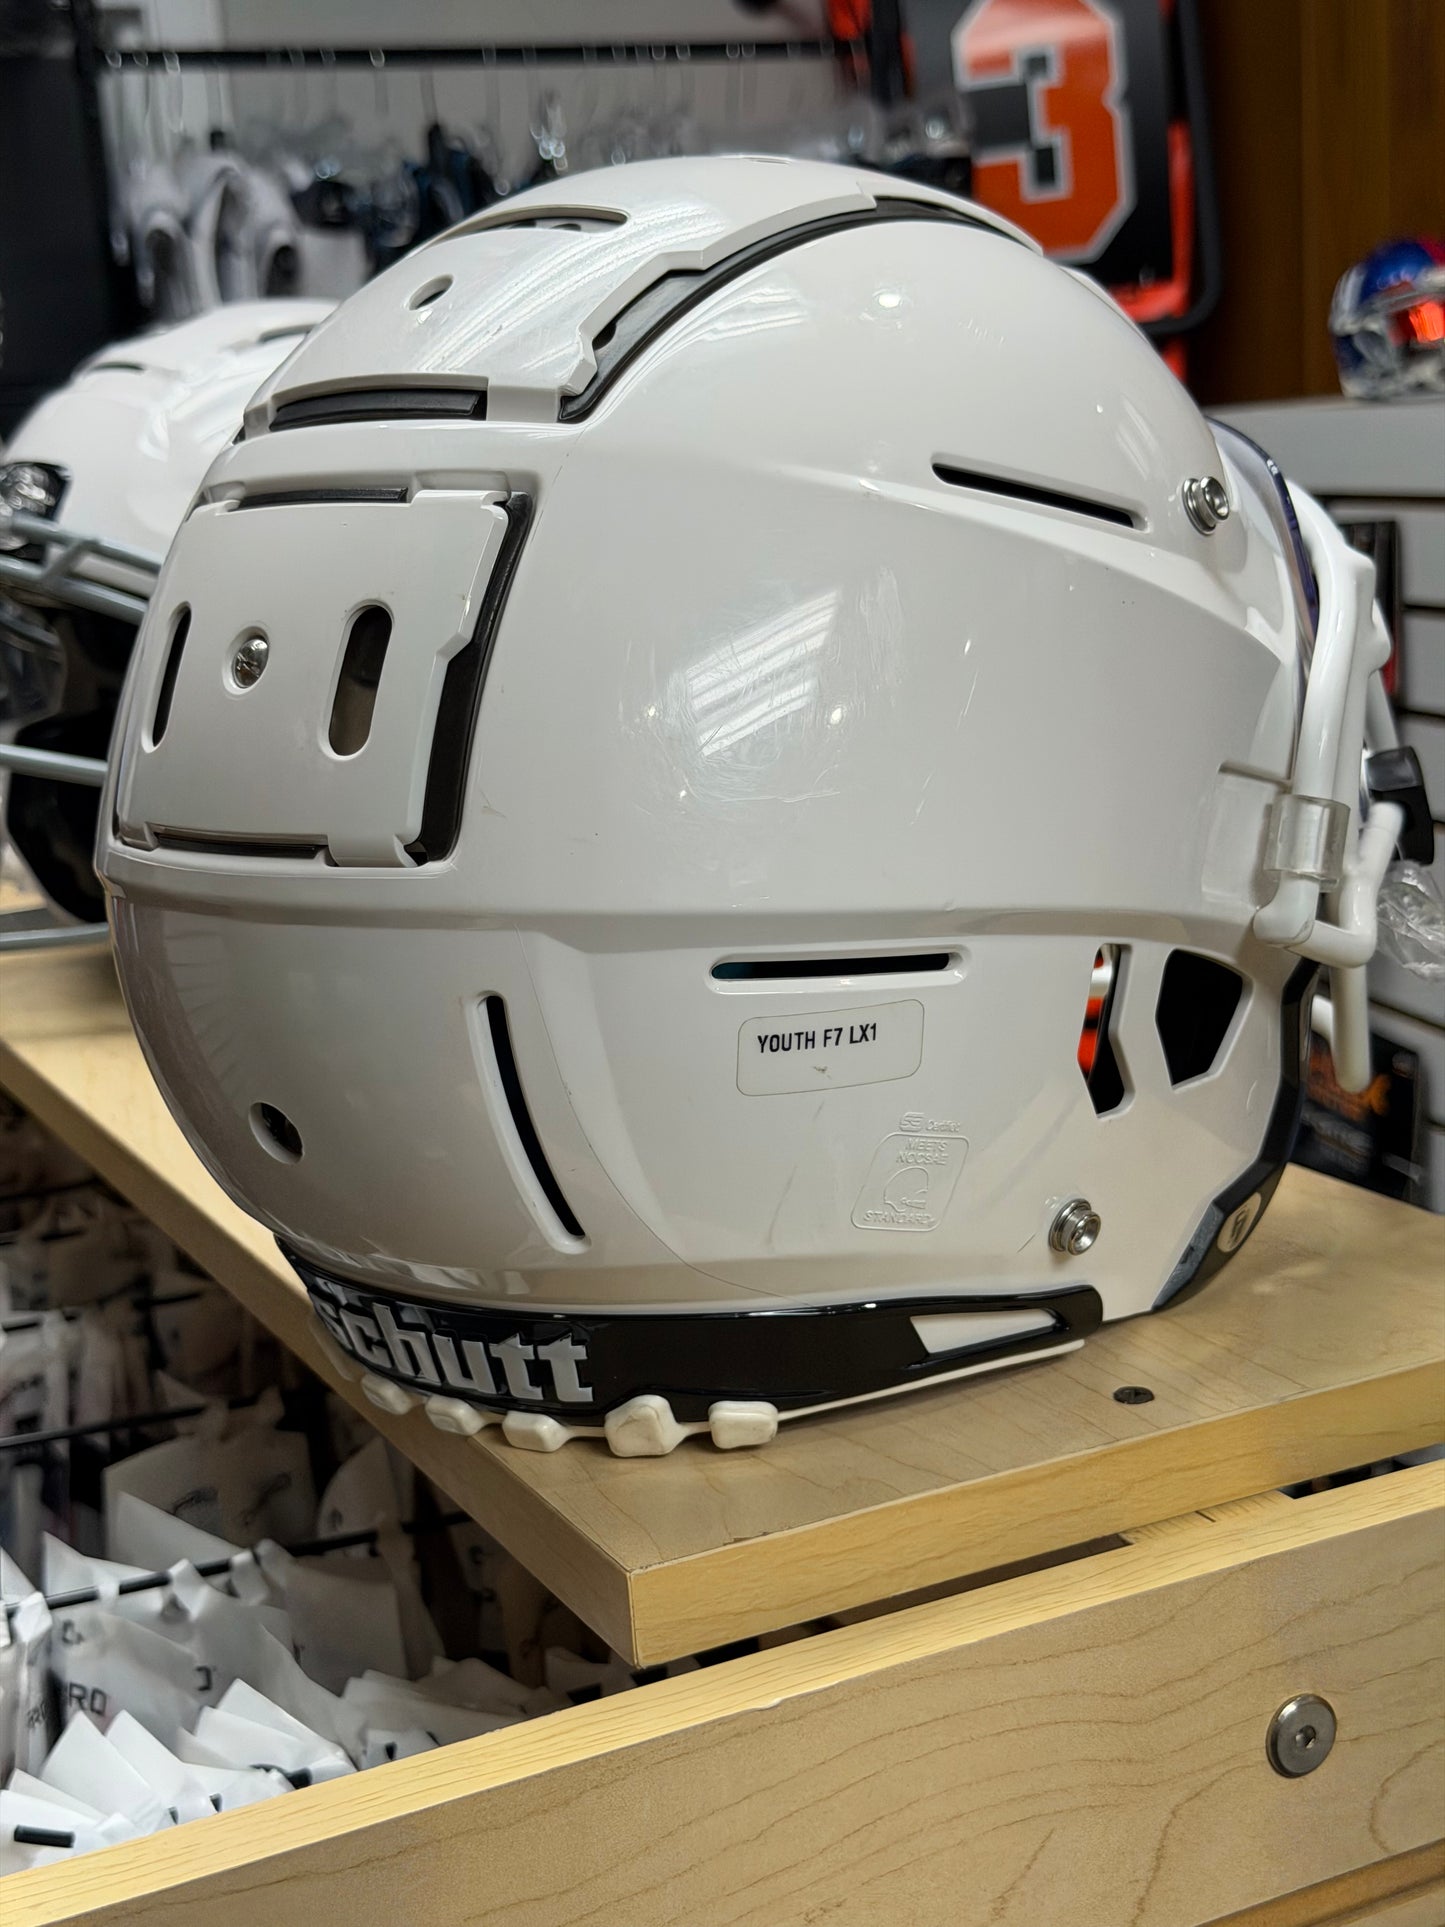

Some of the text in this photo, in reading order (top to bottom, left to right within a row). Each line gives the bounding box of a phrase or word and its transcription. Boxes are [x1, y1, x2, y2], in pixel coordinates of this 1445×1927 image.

[951, 0, 1137, 265] 3
[757, 1022, 877, 1054] YOUTH F7 LX1
[309, 1291, 594, 1402] schutt
